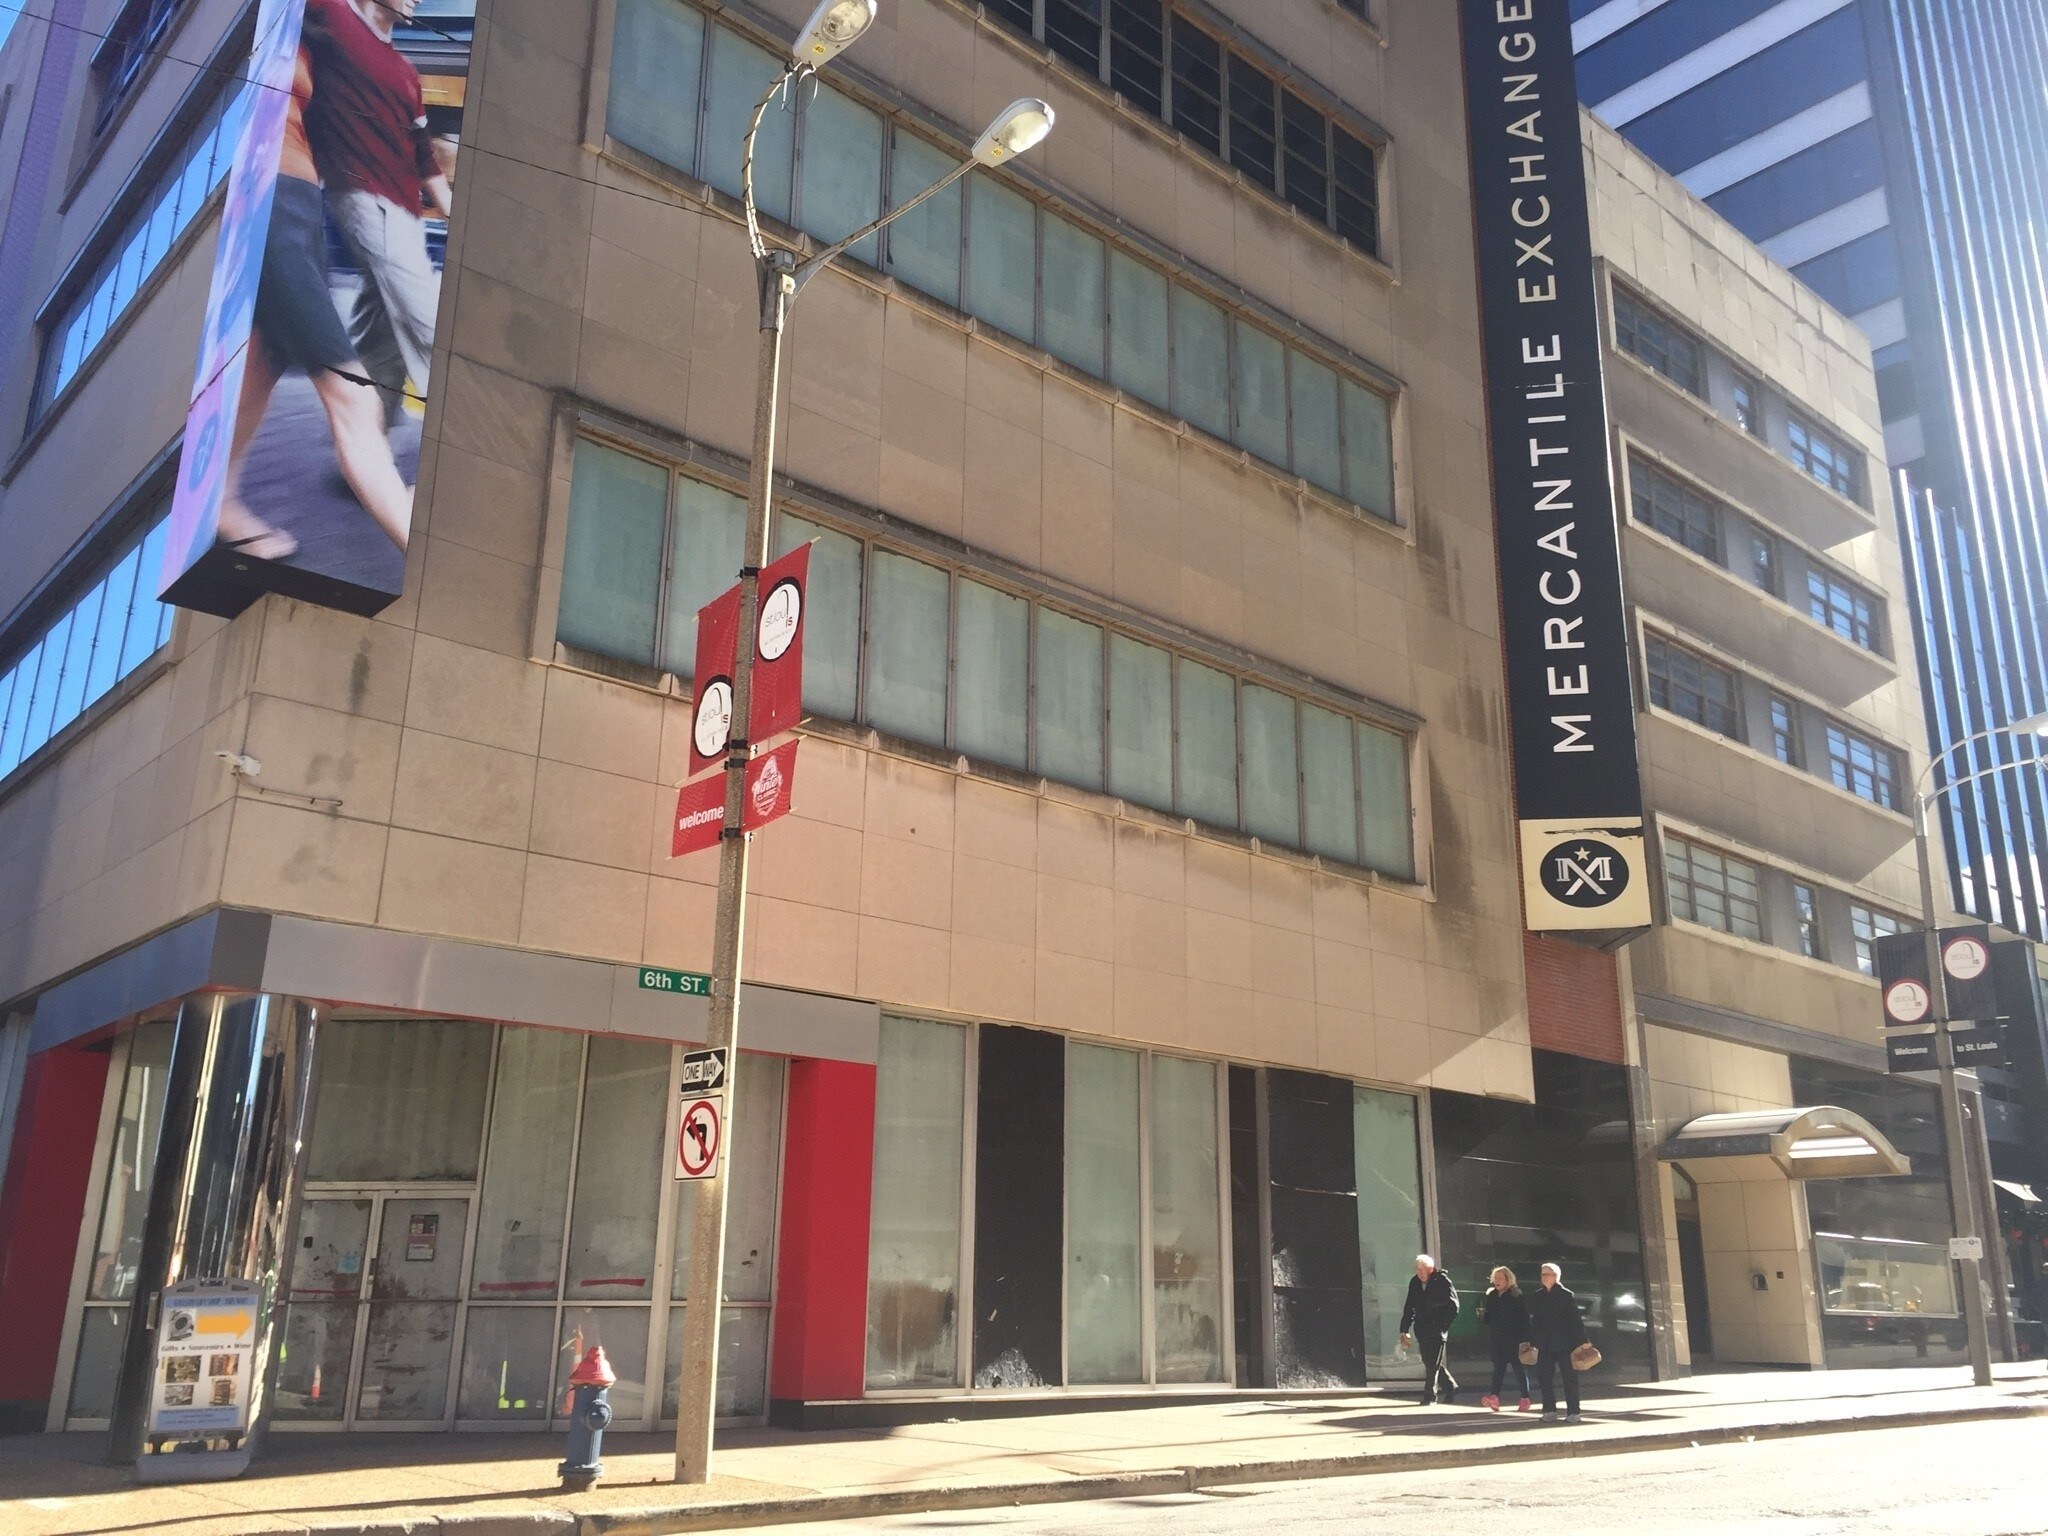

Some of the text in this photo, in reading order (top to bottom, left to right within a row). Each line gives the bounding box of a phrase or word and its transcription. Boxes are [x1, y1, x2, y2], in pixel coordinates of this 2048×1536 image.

[1496, 0, 1594, 753] MERCANTILE EXCHANGE
[679, 806, 724, 831] welcome
[644, 971, 705, 994] 6th ST.
[1976, 1041, 1998, 1050] Louis
[685, 1062, 717, 1080] ONE WAY
